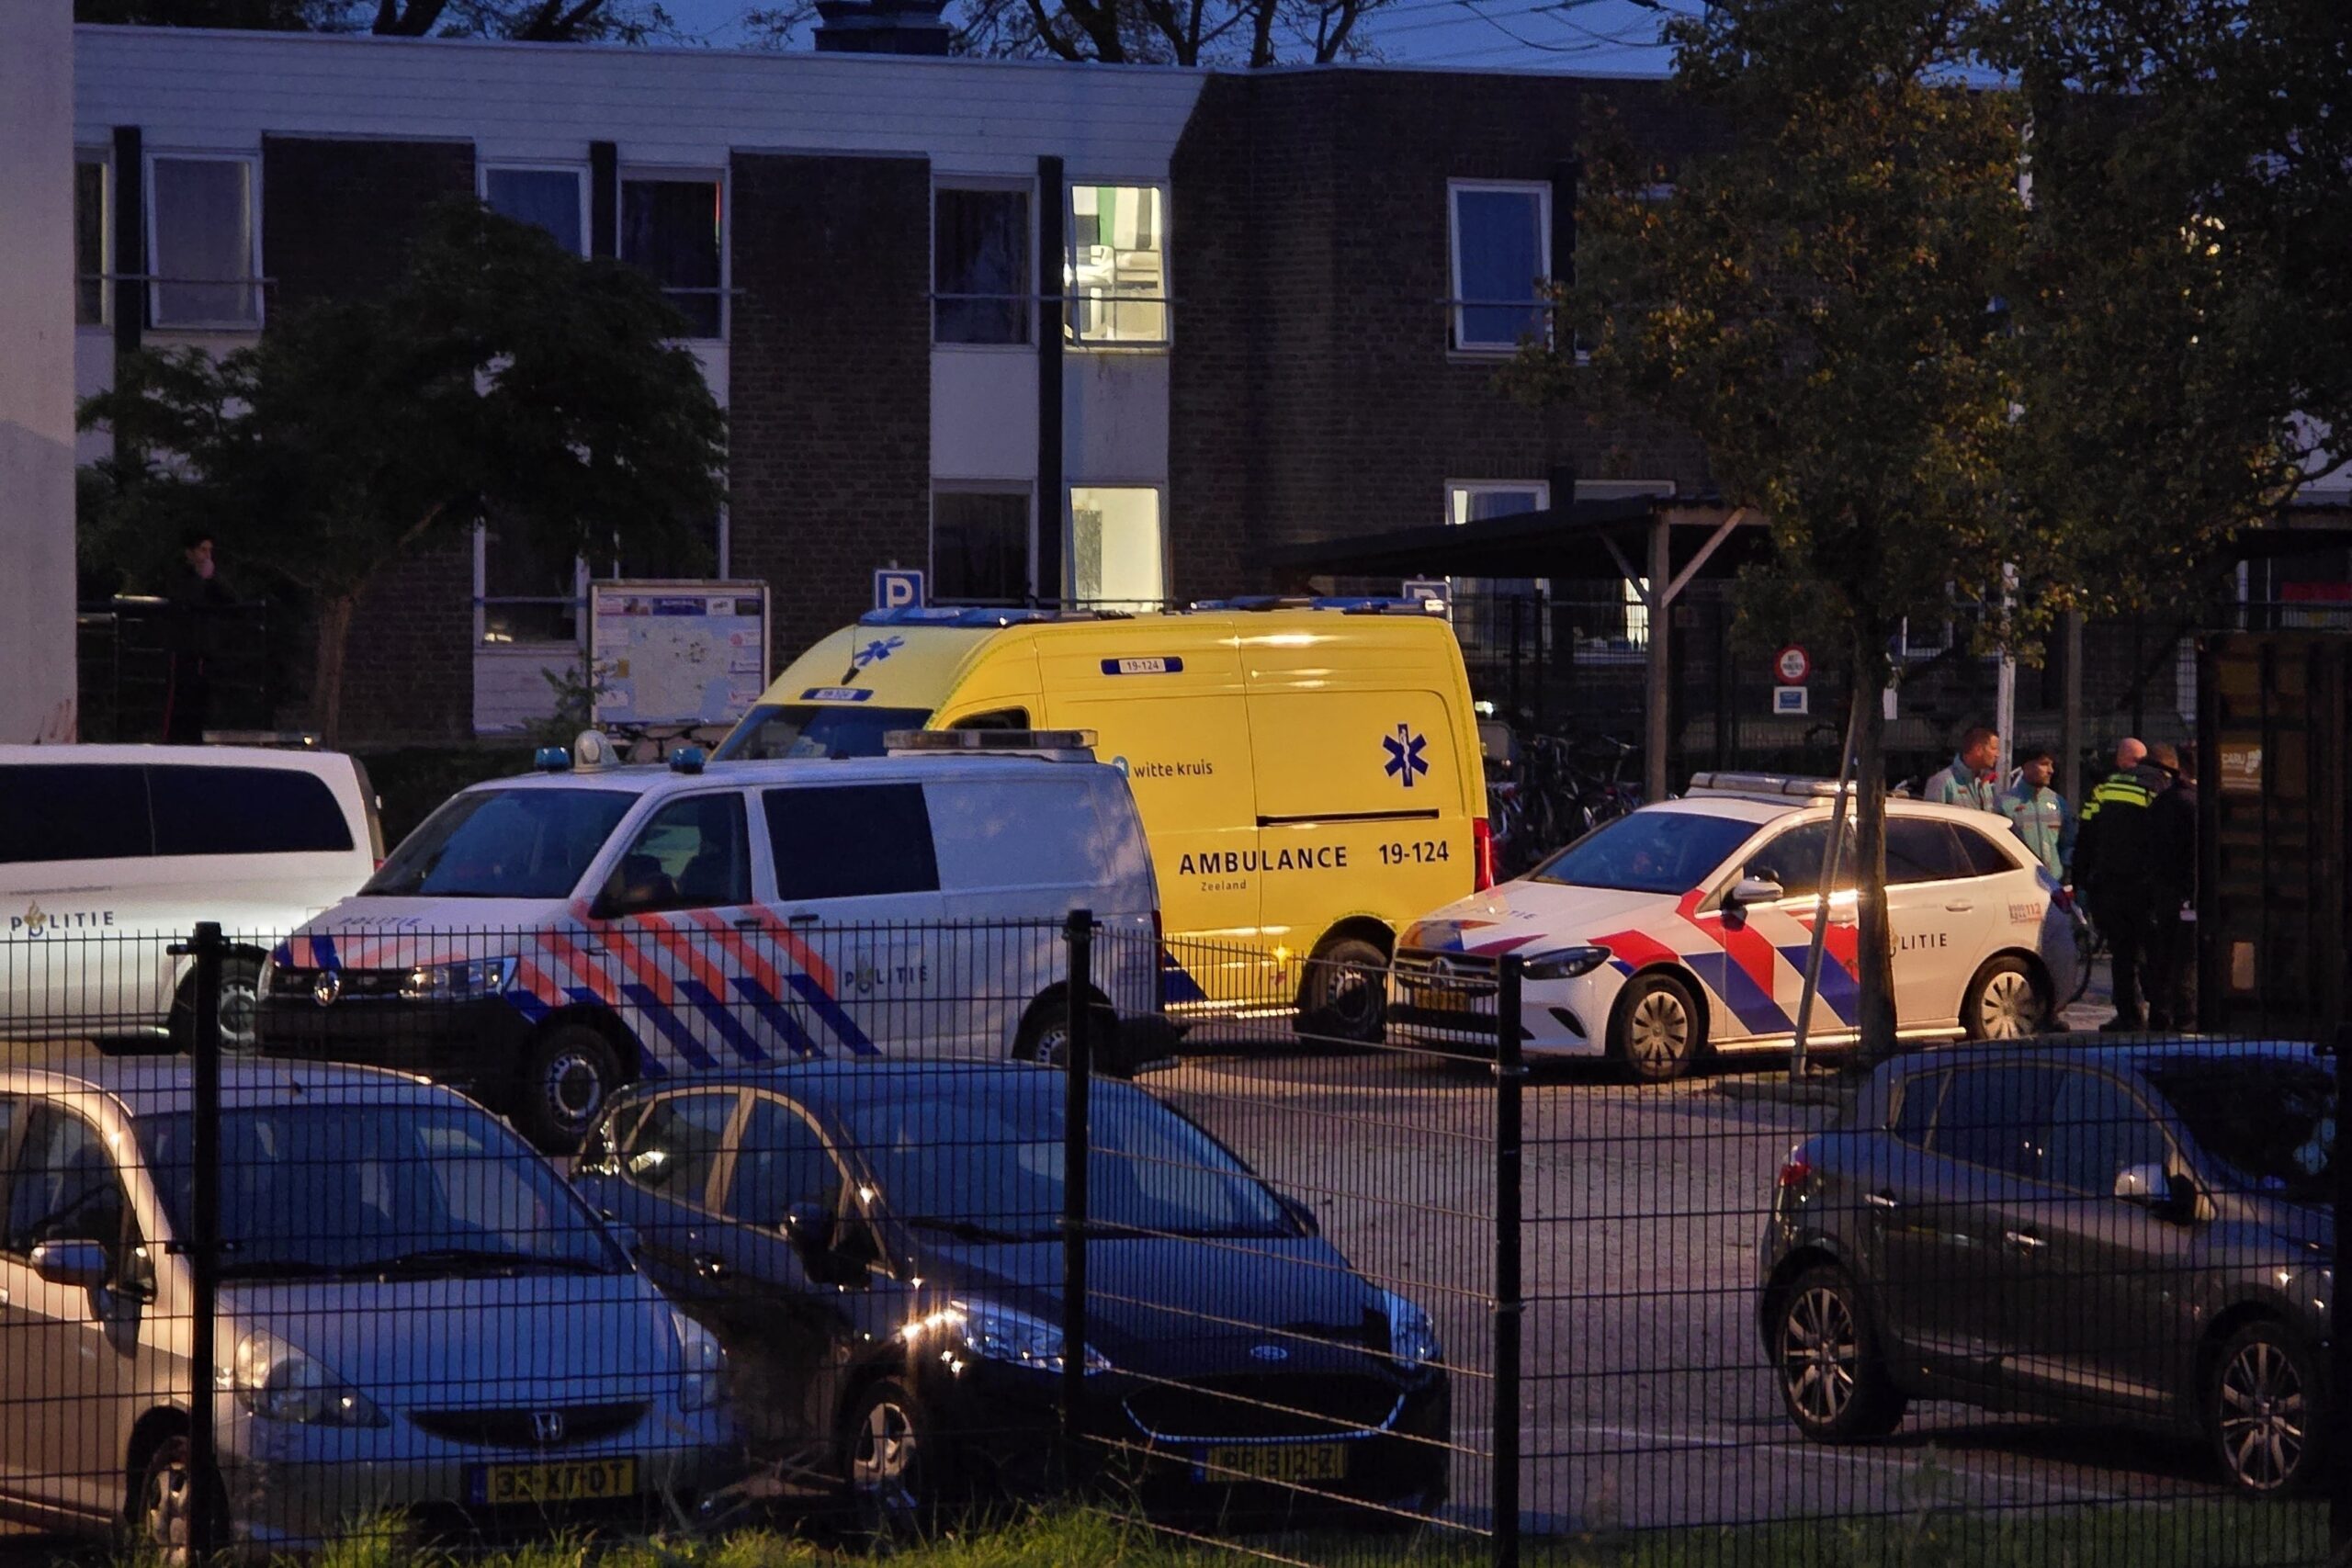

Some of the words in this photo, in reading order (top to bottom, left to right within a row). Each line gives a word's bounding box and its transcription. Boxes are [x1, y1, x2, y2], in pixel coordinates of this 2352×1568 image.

[886, 577, 912, 608] P
[1126, 660, 1159, 671] 19-124
[1134, 761, 1173, 778] witte
[1177, 759, 1213, 775] kruis
[1180, 846, 1348, 874] AMBULANCE
[1379, 840, 1450, 864] 19-124
[1201, 879, 1247, 891] Zeeland
[10, 907, 114, 937] POLITIE
[1891, 932, 1947, 956] LITIE
